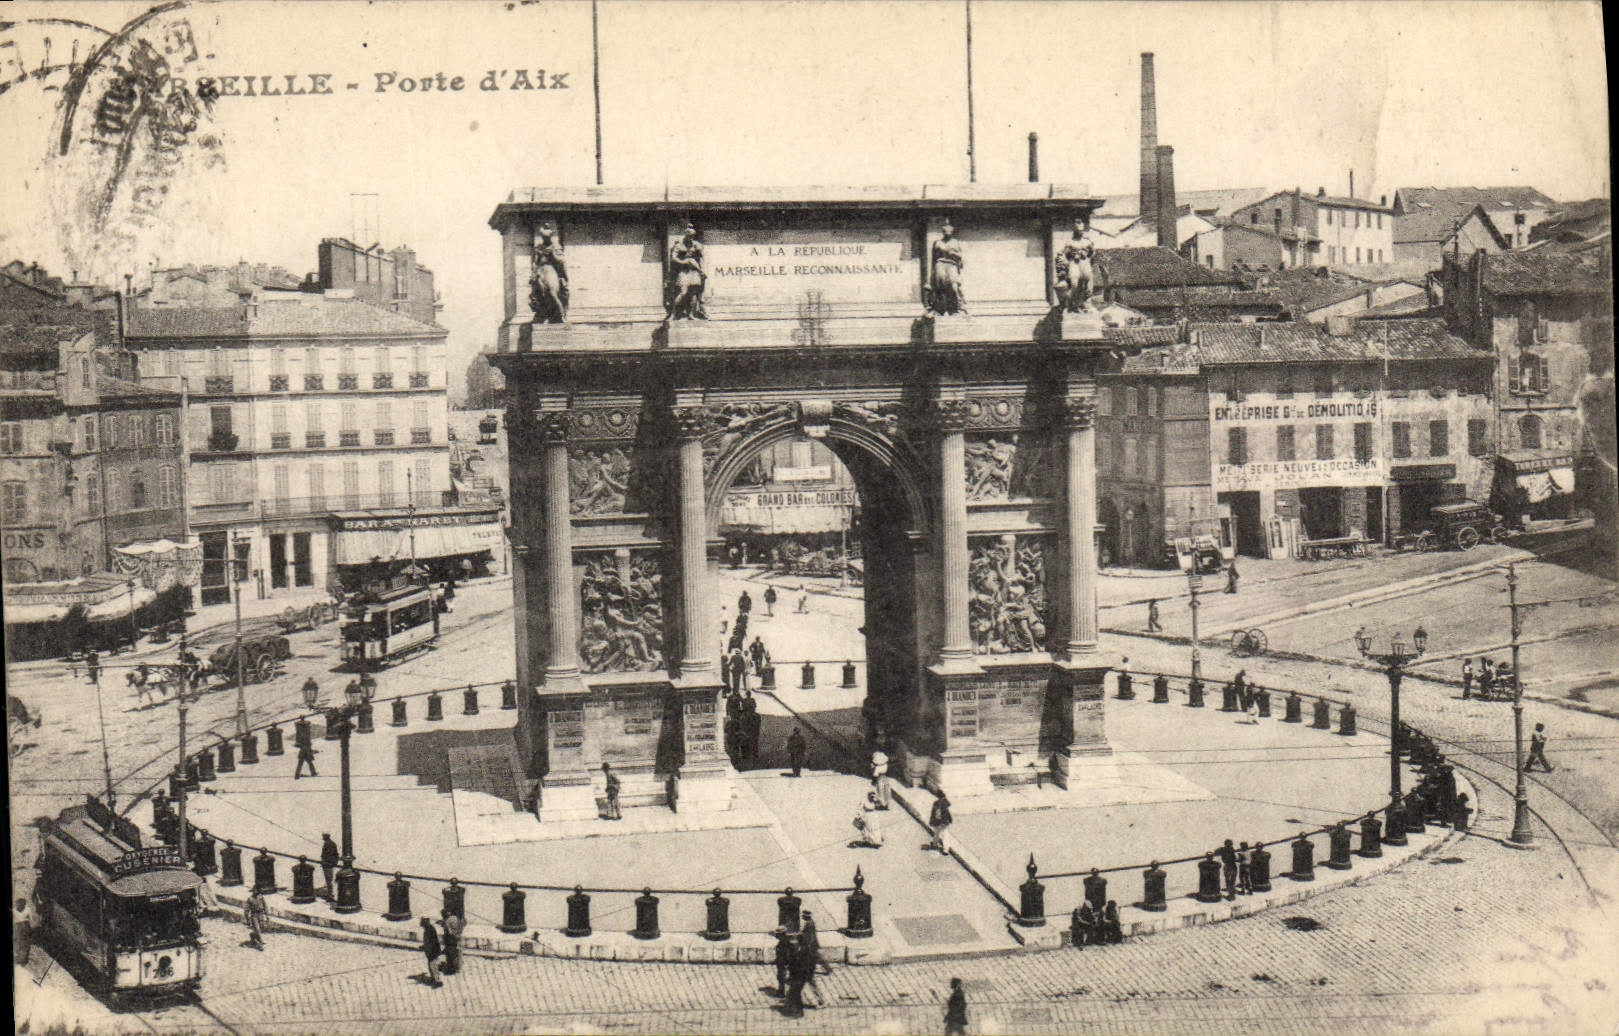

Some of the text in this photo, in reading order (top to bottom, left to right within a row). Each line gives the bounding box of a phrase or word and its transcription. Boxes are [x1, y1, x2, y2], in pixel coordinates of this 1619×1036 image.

[768, 247, 785, 257] LA
[715, 264, 903, 277] MARSEILLE RECONNAISSANTE
[1284, 462, 1316, 473] NEUVE
[757, 493, 784, 506] GRAND
[787, 493, 803, 505] BAR
[344, 519, 378, 529] BAR
[114, 856, 181, 873] CUSENIER
